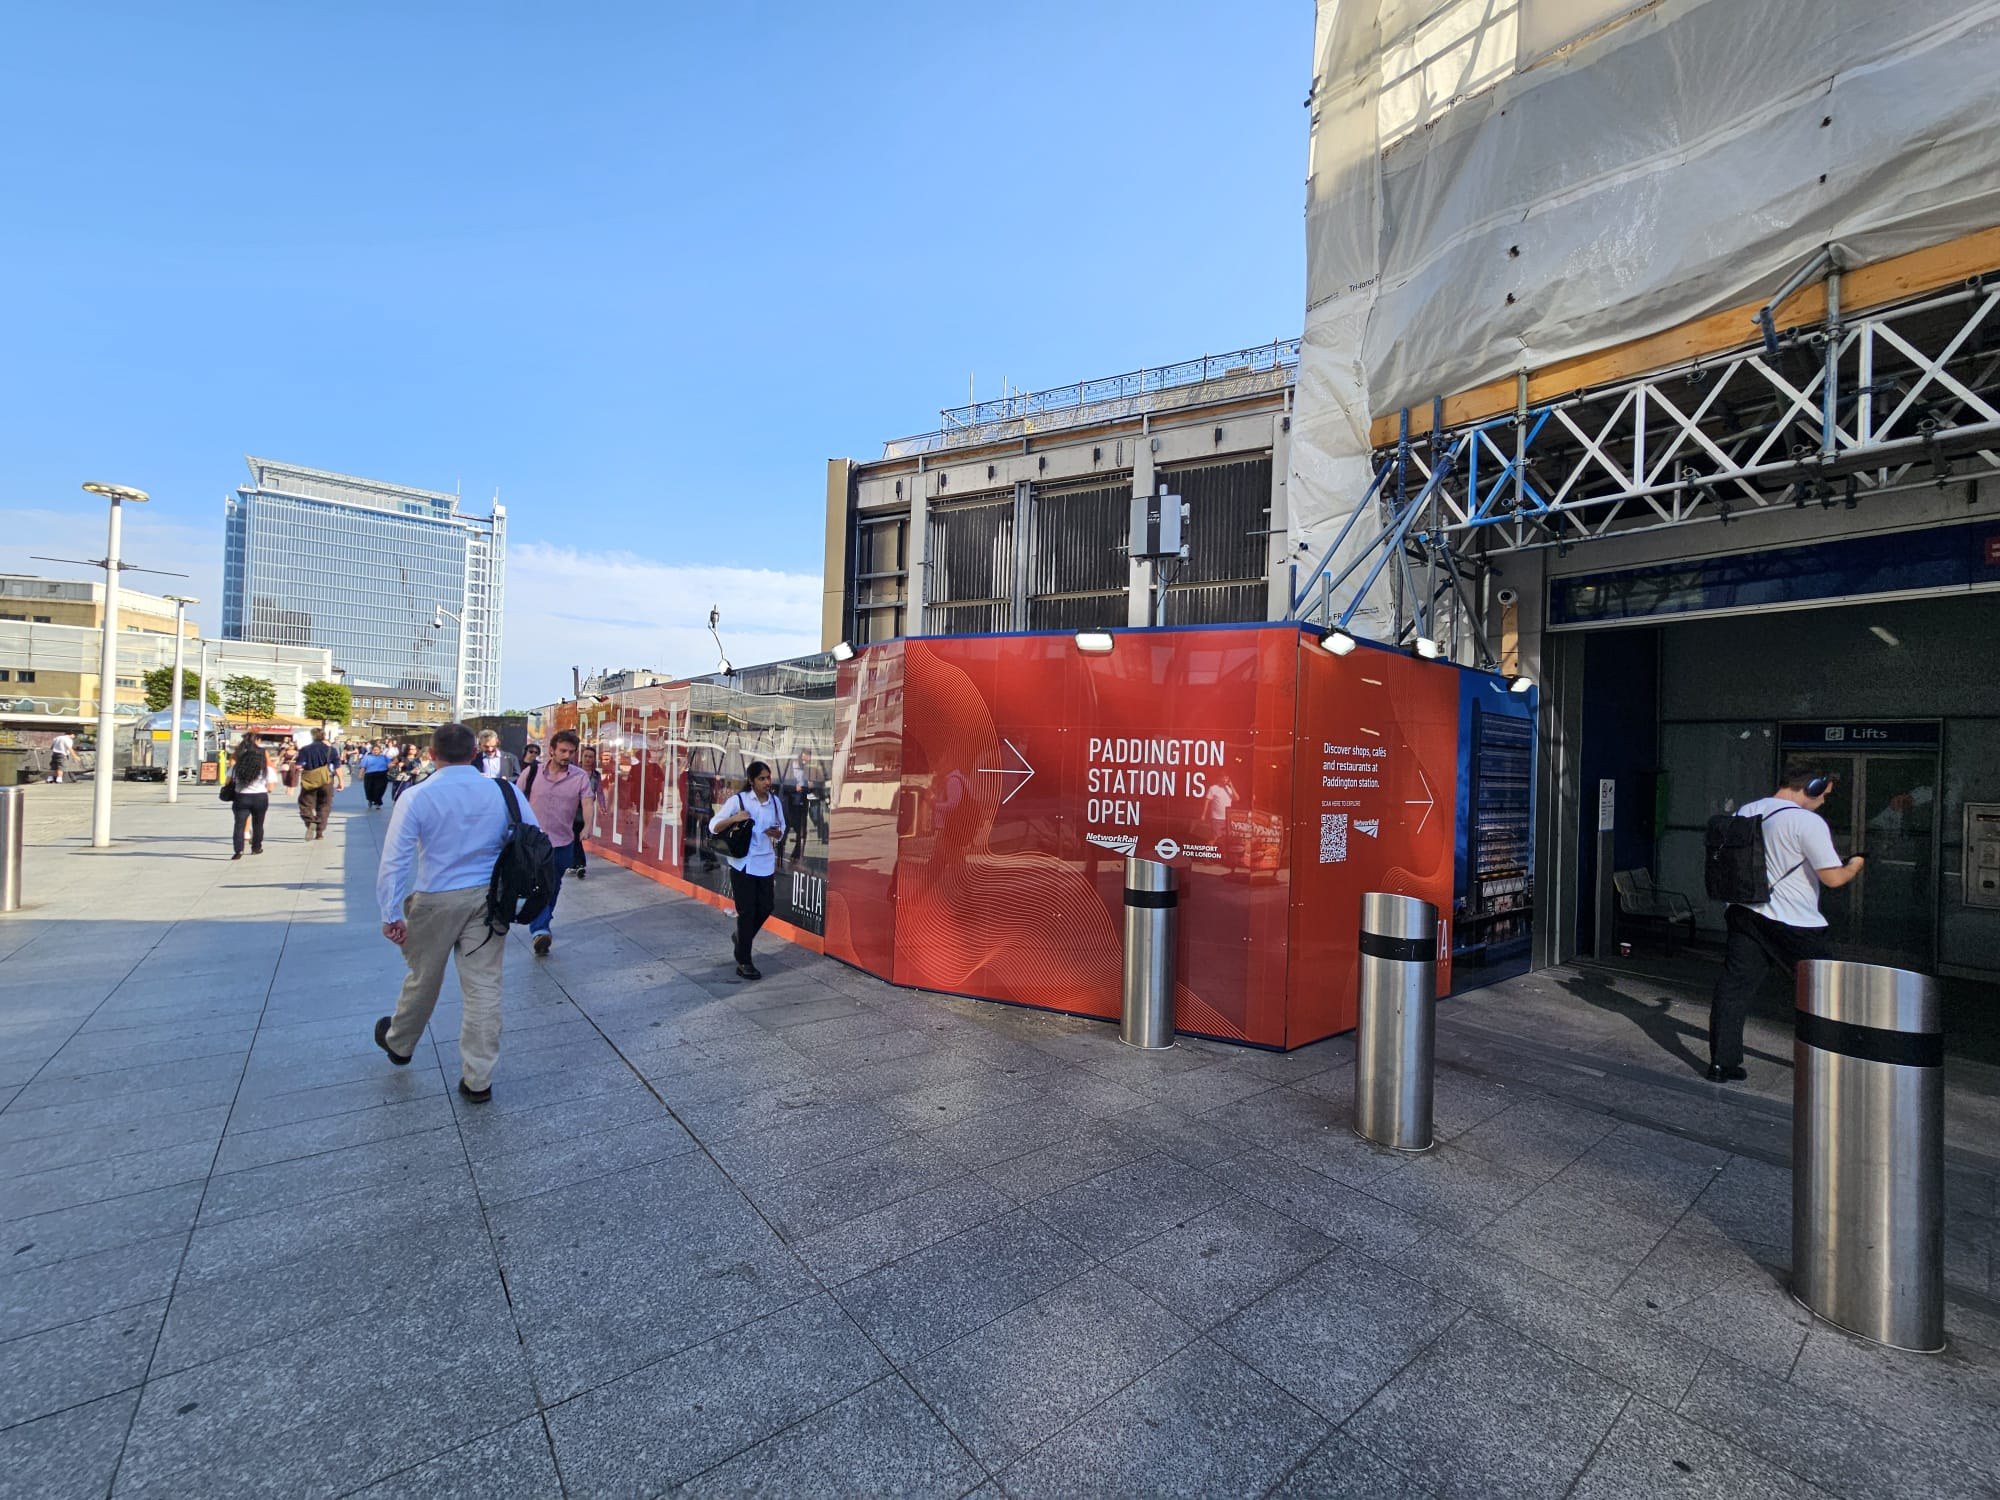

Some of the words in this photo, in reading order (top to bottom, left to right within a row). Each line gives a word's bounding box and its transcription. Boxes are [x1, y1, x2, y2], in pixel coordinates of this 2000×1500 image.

[1852, 728, 1889, 739] Lifts
[1088, 737, 1225, 767] PADDINGTON
[1324, 742, 1351, 754] Discover
[1352, 745, 1371, 758] shops,
[1323, 760, 1336, 770] and
[1336, 762, 1371, 772] restaurants
[1371, 763, 1378, 773] at
[1087, 768, 1176, 797] STATION
[1184, 771, 1206, 798] IS
[1322, 776, 1358, 790] Paddington
[1358, 777, 1380, 788] station.
[1086, 798, 1141, 826] OPEN
[1182, 844, 1218, 852] TRANSPORT
[792, 870, 822, 916] DELTA
